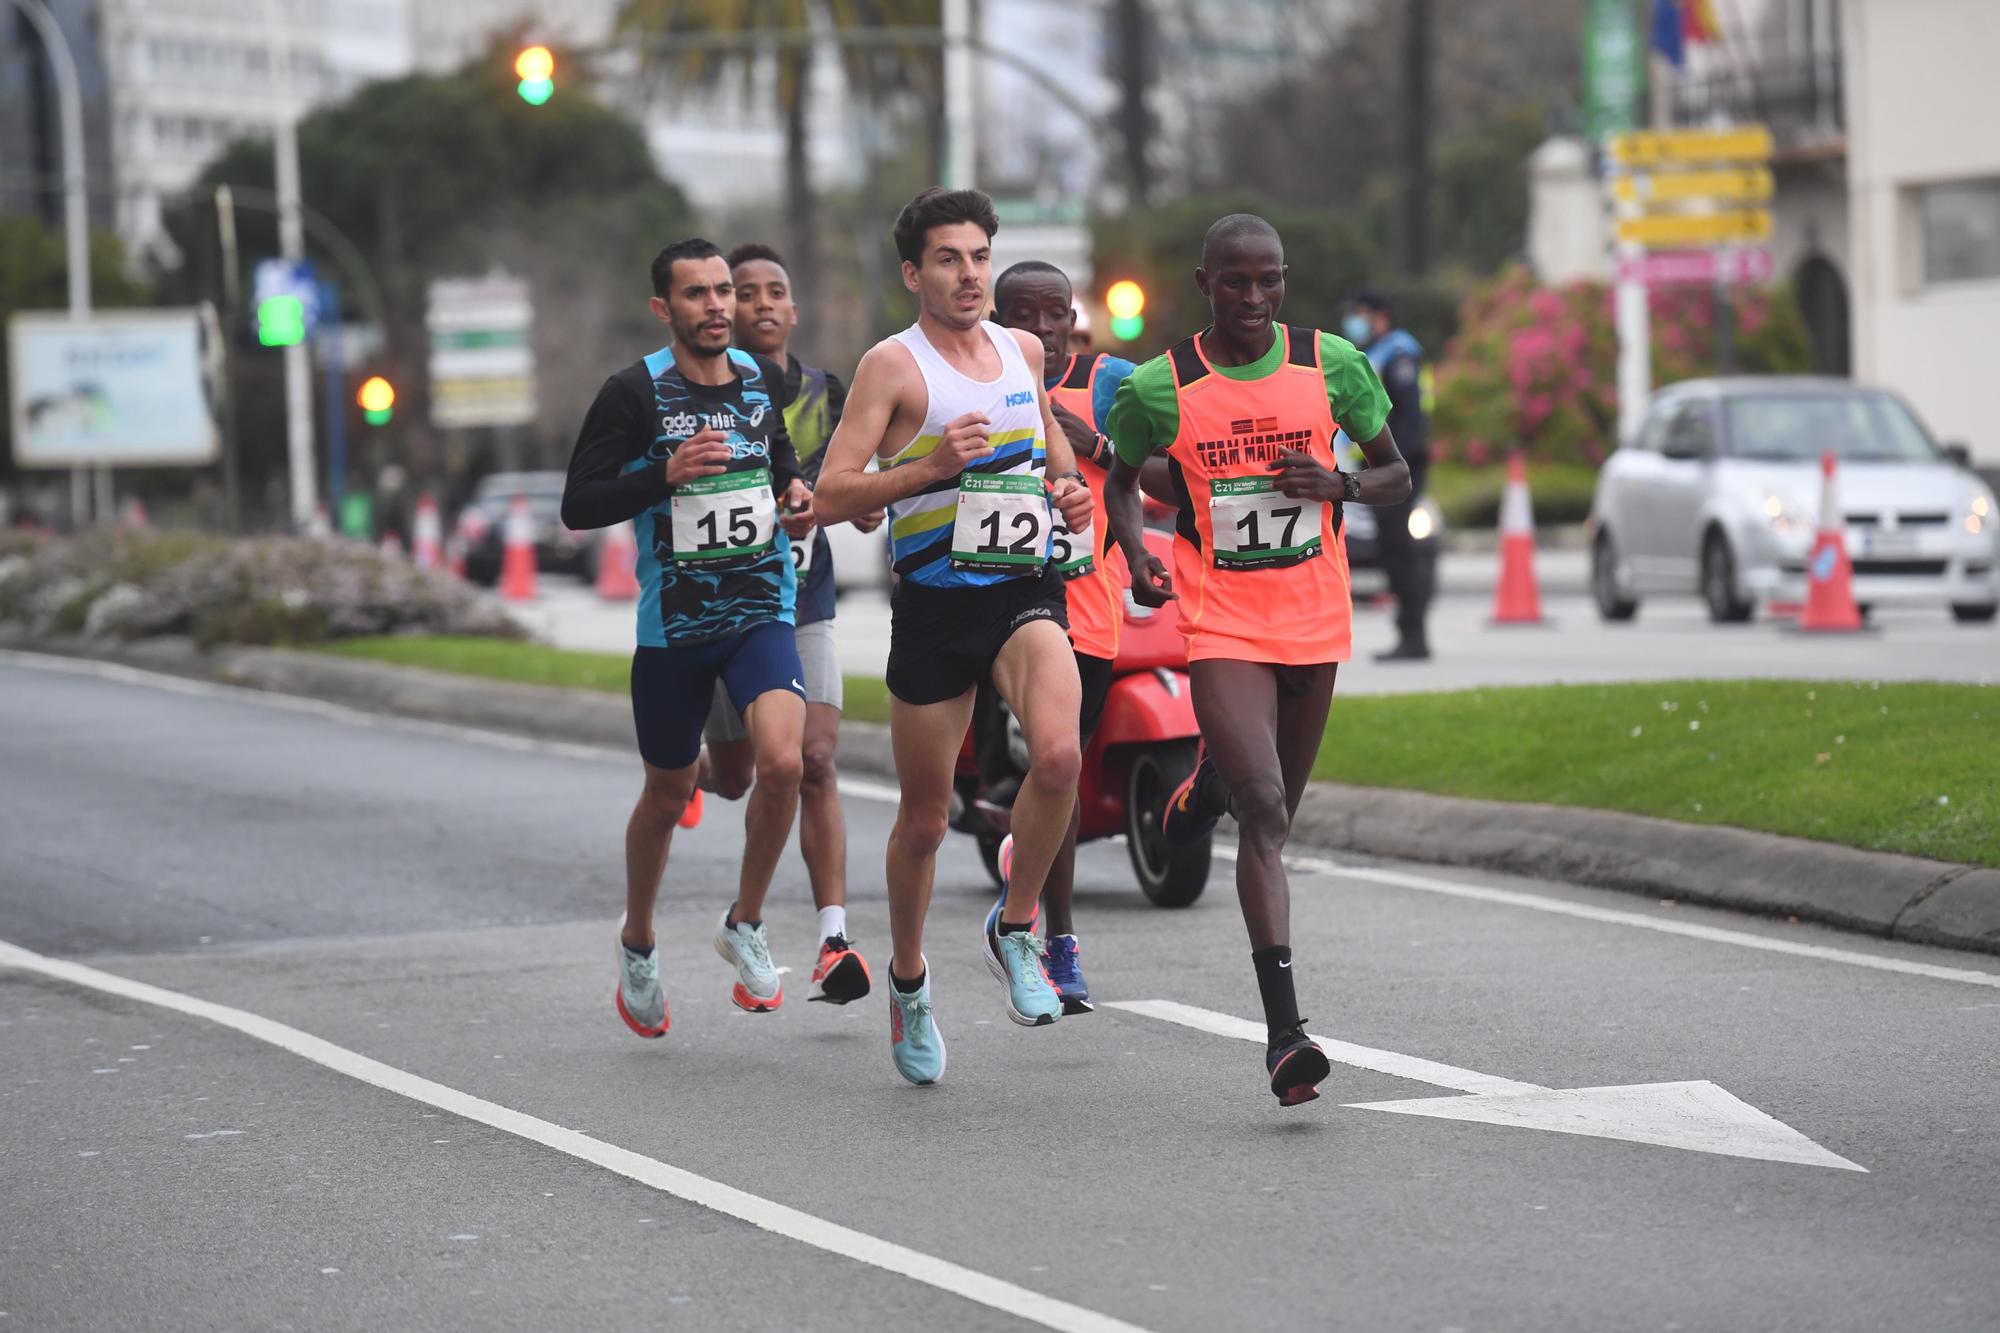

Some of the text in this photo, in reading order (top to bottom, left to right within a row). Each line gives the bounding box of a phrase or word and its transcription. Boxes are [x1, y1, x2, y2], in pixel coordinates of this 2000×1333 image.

[1005, 391, 1034, 407] HOKA
[662, 411, 697, 429] ada
[1196, 438, 1240, 467] TEAM
[965, 479, 982, 489] C21
[1214, 483, 1232, 493] C21
[697, 506, 757, 551] 15
[977, 510, 1039, 555] 12
[1237, 505, 1302, 552] 17
